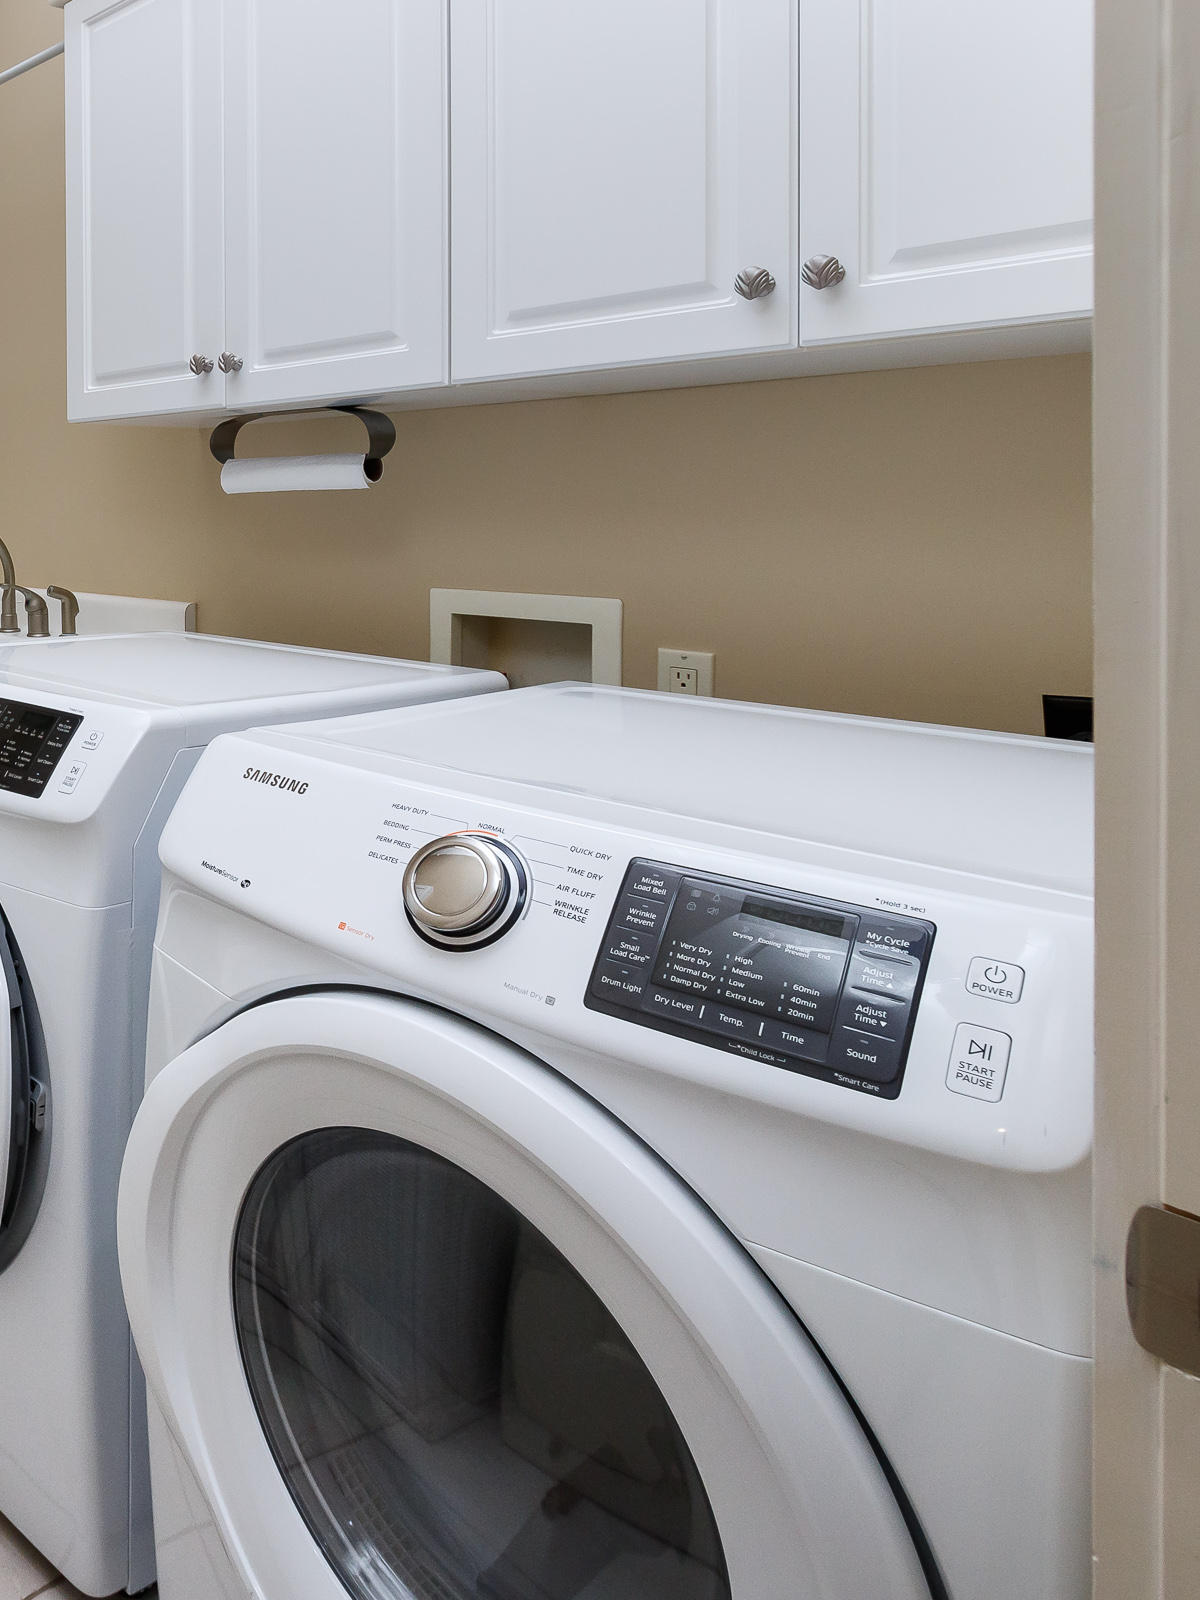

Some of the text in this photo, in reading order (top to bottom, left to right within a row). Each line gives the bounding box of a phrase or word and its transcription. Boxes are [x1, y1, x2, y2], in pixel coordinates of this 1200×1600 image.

[243, 767, 309, 795] SAMSUNG
[391, 803, 430, 816] HEAVY DUTY
[383, 819, 411, 831] BEDDING
[477, 822, 505, 834] NORMAL
[376, 835, 412, 849] PERM PRESS
[368, 851, 399, 865] DELICATES
[569, 845, 613, 861] QUICK DRY
[567, 866, 604, 881] TIME DRY
[641, 876, 664, 887] Mixed
[556, 884, 597, 900] AIR FLUFF
[633, 882, 667, 896] Load Bell
[554, 900, 590, 916] WRINKLE
[629, 907, 657, 920] Wrinkle
[553, 908, 588, 924] RELEASE
[626, 914, 655, 928] Prevent
[732, 931, 754, 942] Drying
[757, 937, 782, 949] Cooling
[866, 931, 911, 949] My Cycle
[610, 947, 628, 958] Load
[620, 941, 640, 952] Small
[680, 941, 713, 956] Very Dry
[676, 953, 712, 968] More Dry
[734, 955, 754, 966] High
[673, 964, 716, 982] Normal Dry
[731, 966, 763, 981] Medium
[863, 965, 894, 980] Adjust
[601, 975, 642, 994] Drum Light
[670, 975, 708, 992] Damp Dry
[728, 978, 746, 989] Low
[861, 974, 885, 987] Time
[503, 981, 528, 996] Manual
[792, 983, 821, 997] 60min
[971, 982, 1014, 999] POWER
[654, 994, 695, 1012] Dry Level
[725, 990, 766, 1007] Extra Low
[790, 996, 818, 1010] 40min
[787, 1008, 815, 1022] 20min
[855, 1003, 888, 1019] Adjust
[719, 1012, 745, 1028] Temp.
[853, 1012, 878, 1026] Time
[781, 1031, 805, 1045] Time
[759, 1051, 775, 1061] Lock
[846, 1048, 877, 1064] Sound
[958, 1060, 996, 1078] START
[862, 1081, 880, 1092] Care
[955, 1072, 993, 1090] PAUSE
